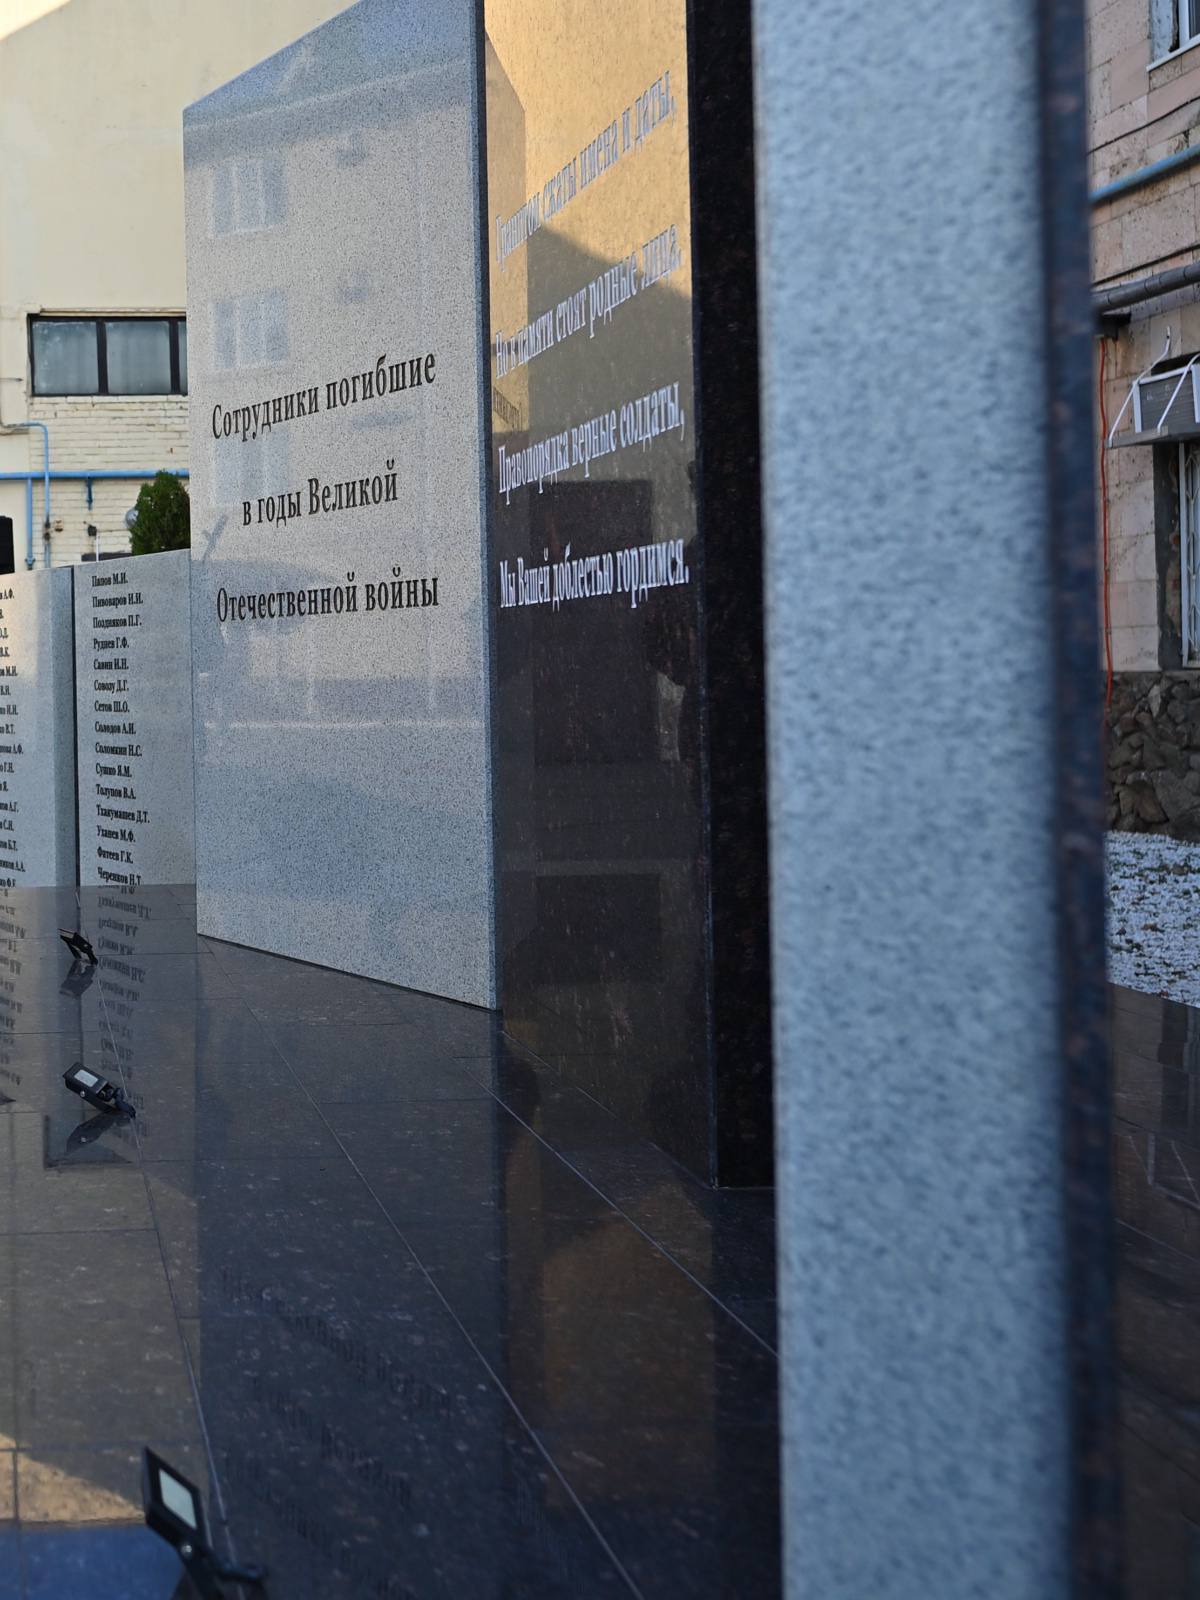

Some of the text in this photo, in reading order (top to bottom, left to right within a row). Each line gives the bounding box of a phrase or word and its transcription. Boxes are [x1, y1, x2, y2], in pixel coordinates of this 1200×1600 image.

[580, 119, 619, 190] имена
[623, 107, 631, 152] и
[635, 70, 675, 145] даты,
[496, 330, 509, 379] Но
[518, 309, 554, 366] памяти
[556, 288, 587, 342] стоят
[589, 252, 637, 339] родные
[212, 353, 436, 442] Сотрудники погибшие
[499, 381, 684, 505] Правопорядка верные солдаты,
[242, 459, 398, 528] в годы Великой
[217, 567, 438, 622] Отечественной войны
[500, 539, 689, 612] Мы Вашей доблестью гордимся.
